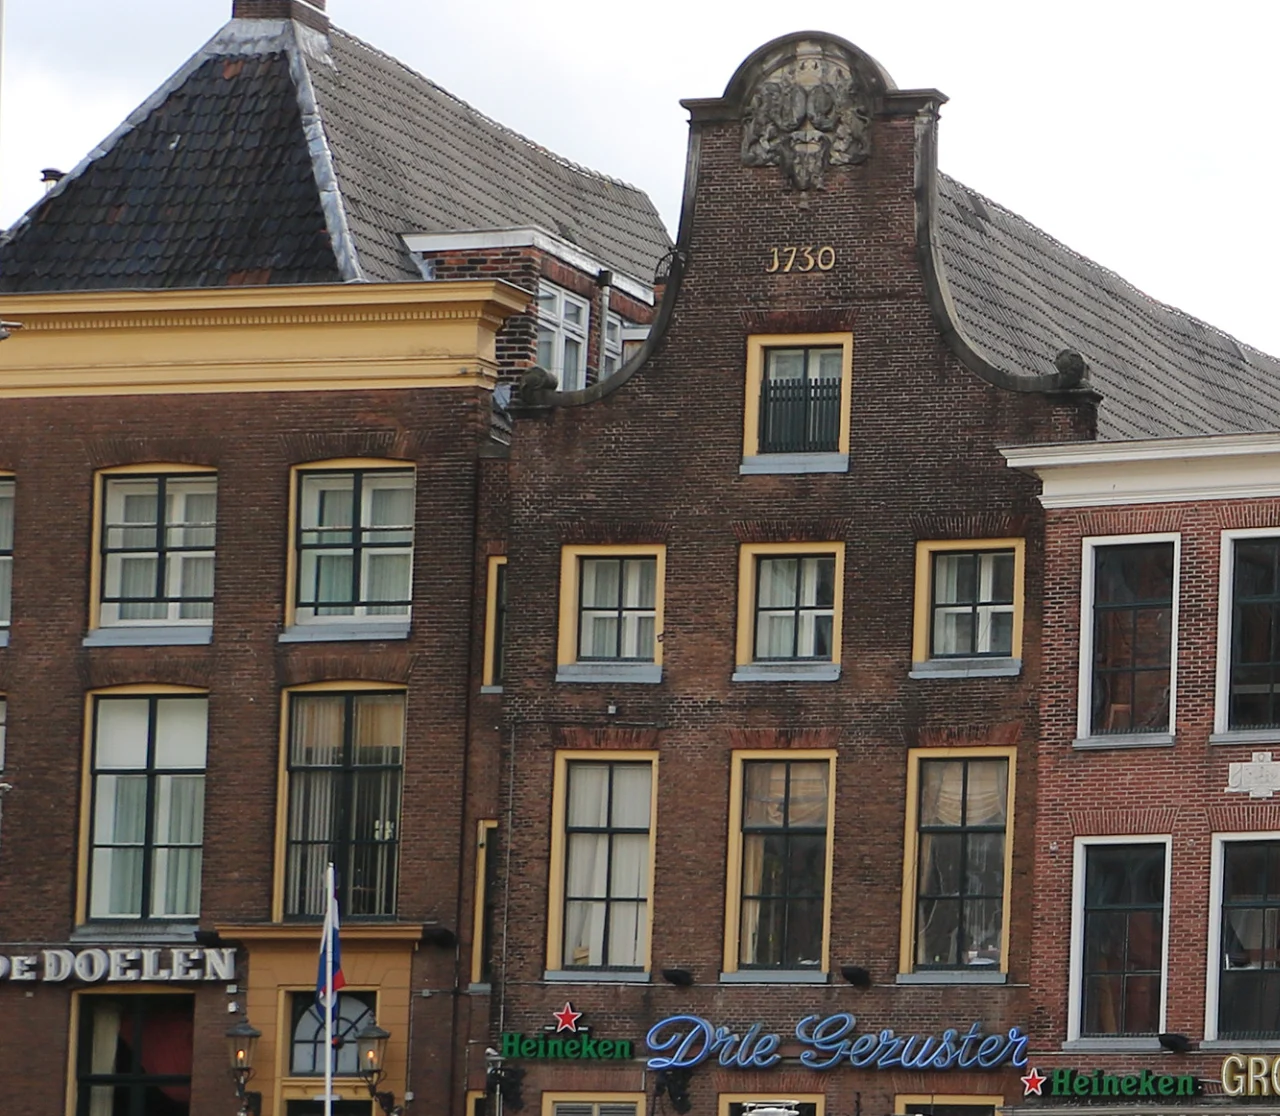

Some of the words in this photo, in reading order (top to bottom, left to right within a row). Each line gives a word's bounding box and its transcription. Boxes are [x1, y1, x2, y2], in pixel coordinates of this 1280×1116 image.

[765, 246, 836, 273] 1730
[43, 948, 238, 982] DOELEN
[502, 1031, 632, 1060] Heineken
[645, 1014, 782, 1070] Drie
[1051, 1068, 1197, 1097] Heineken
